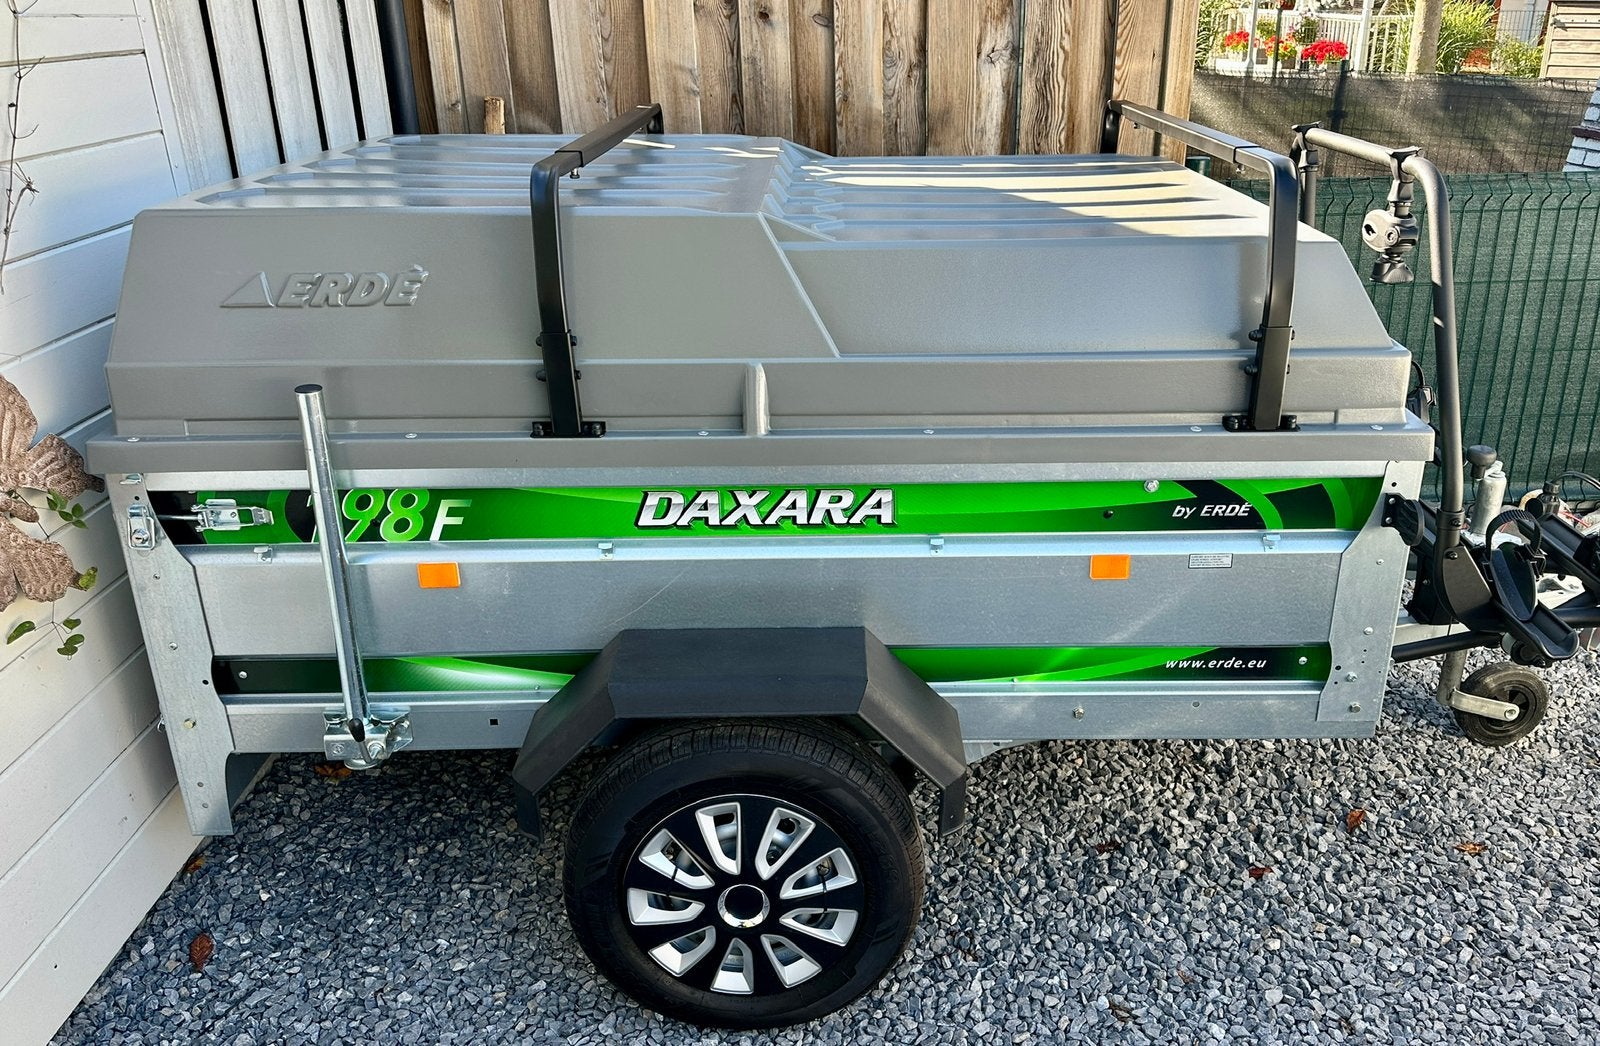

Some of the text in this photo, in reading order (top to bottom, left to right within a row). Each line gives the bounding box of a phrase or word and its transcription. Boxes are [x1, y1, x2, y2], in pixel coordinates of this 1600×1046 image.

[306, 488, 472, 543] 98 F
[635, 489, 897, 528] DAXARA
[1172, 505, 1196, 519] by
[1165, 657, 1267, 669] www.erde.eu
